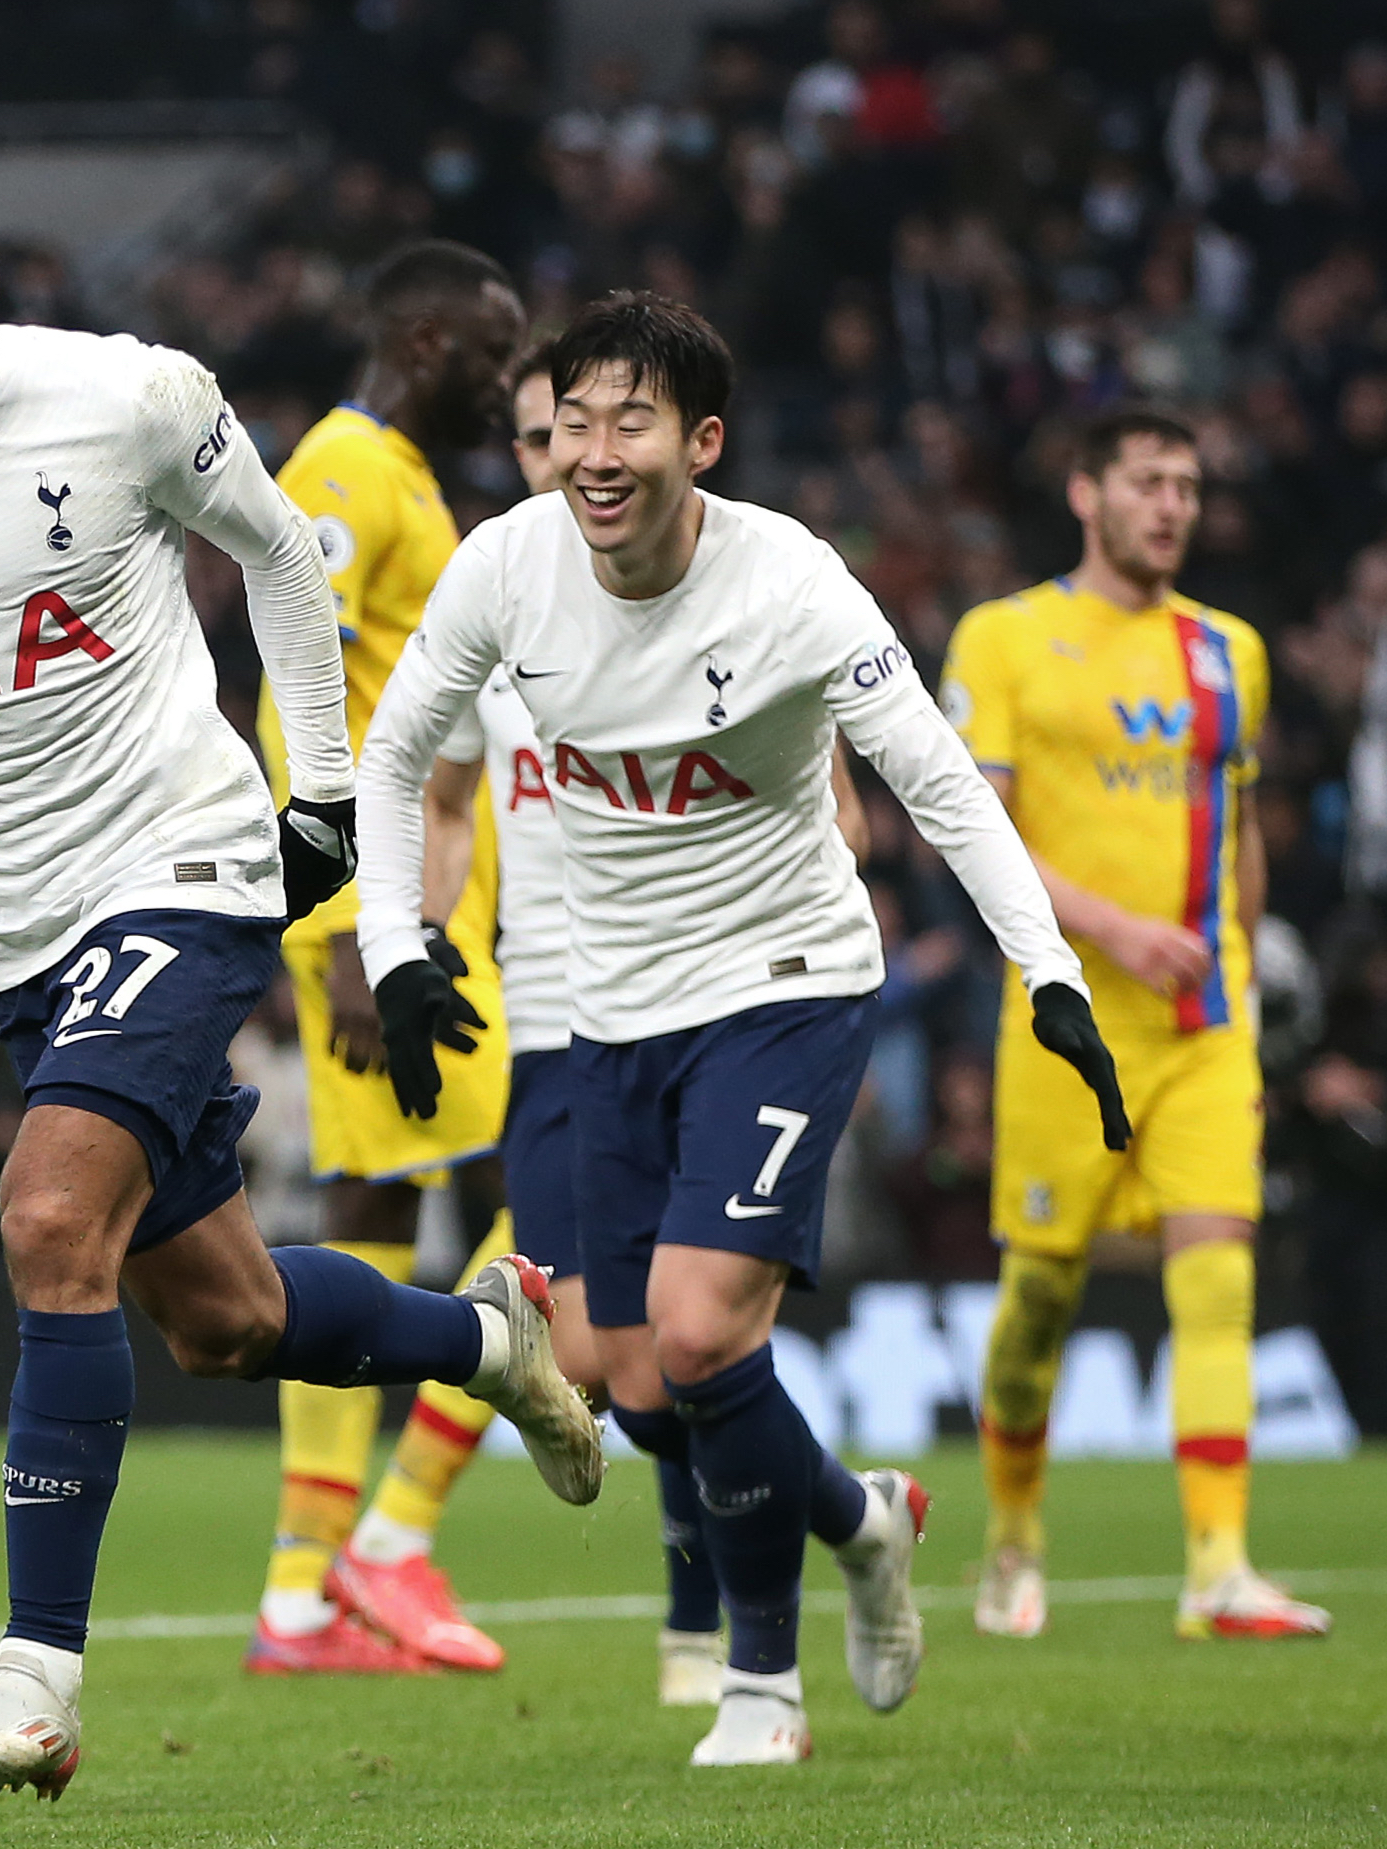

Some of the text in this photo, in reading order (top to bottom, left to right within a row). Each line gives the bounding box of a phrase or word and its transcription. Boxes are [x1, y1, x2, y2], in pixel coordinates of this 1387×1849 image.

[554, 742, 756, 816] AIA
[56, 934, 180, 1033] 27
[752, 1104, 811, 1198] 7
[2, 1463, 82, 1496] SPURS
